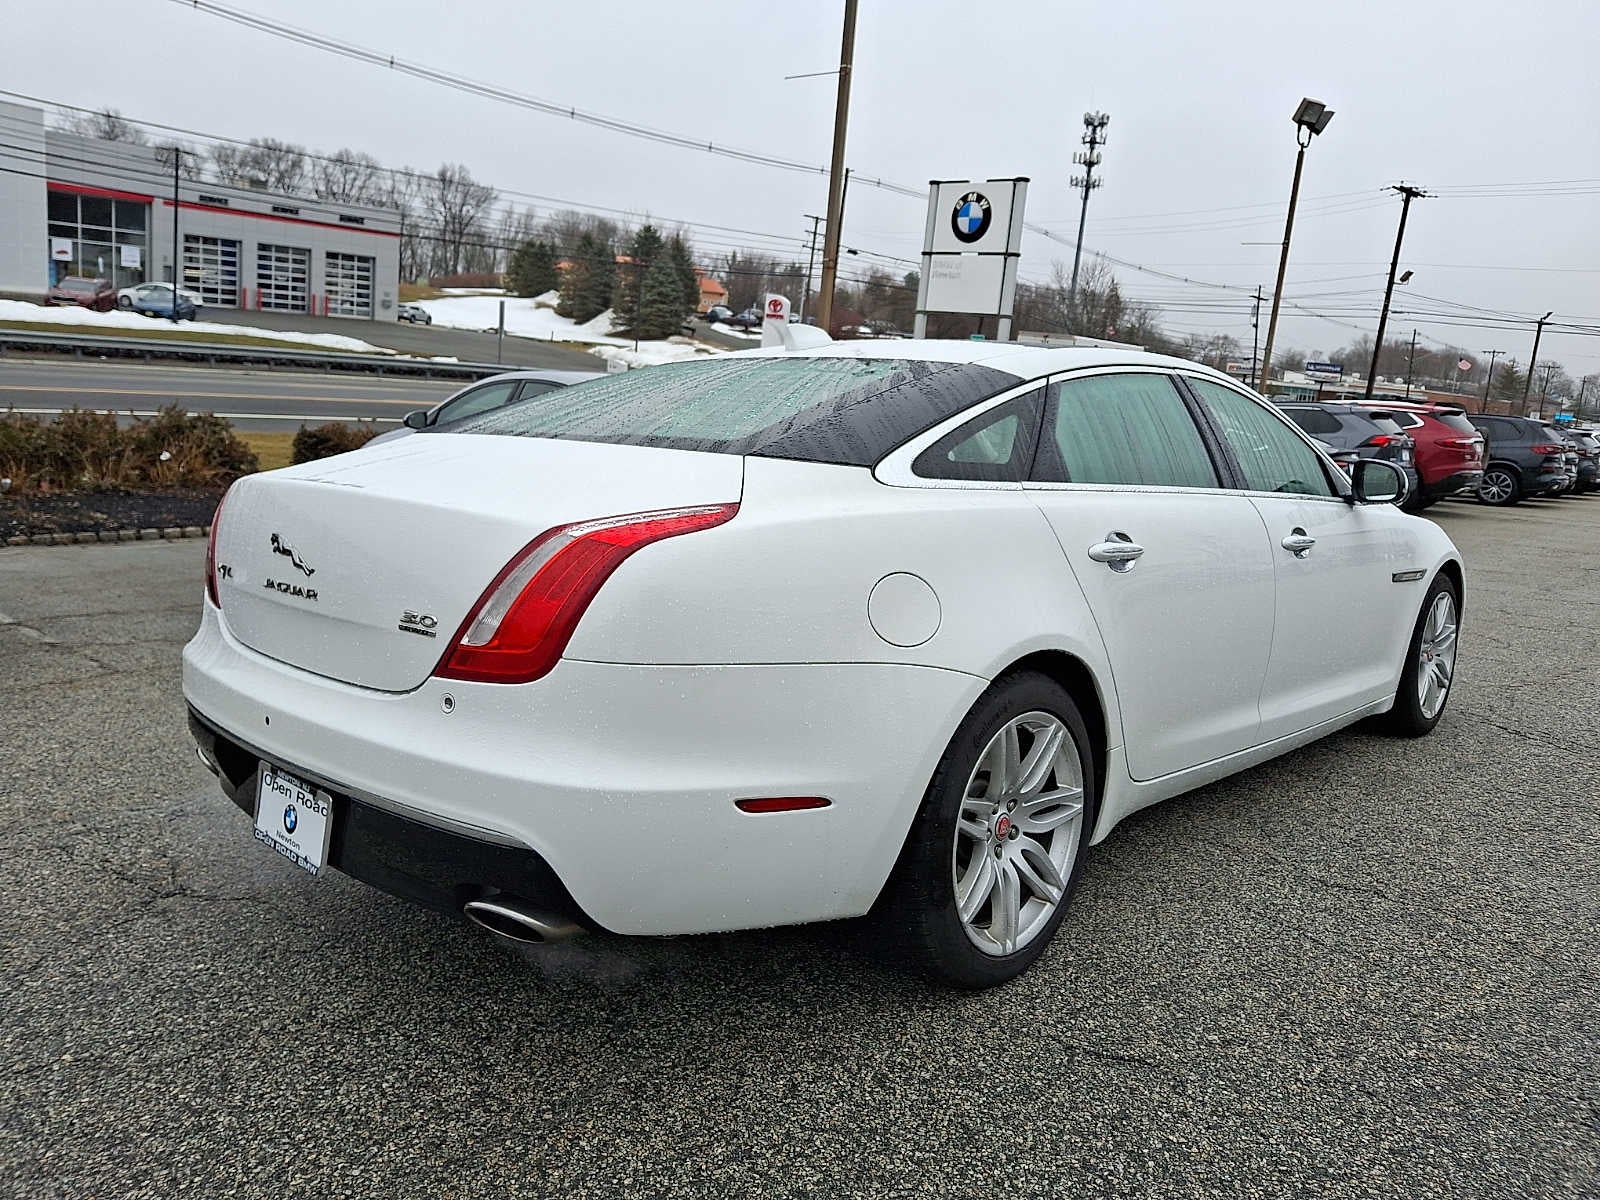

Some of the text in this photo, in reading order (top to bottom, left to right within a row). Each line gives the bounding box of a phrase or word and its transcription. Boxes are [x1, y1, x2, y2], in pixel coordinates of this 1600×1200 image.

[956, 192, 990, 210] BMW
[264, 578, 319, 601] JAGUAR
[264, 773, 292, 799] Open
[276, 829, 301, 851] Newton
[254, 829, 318, 876] OPEN ROAD BMW
